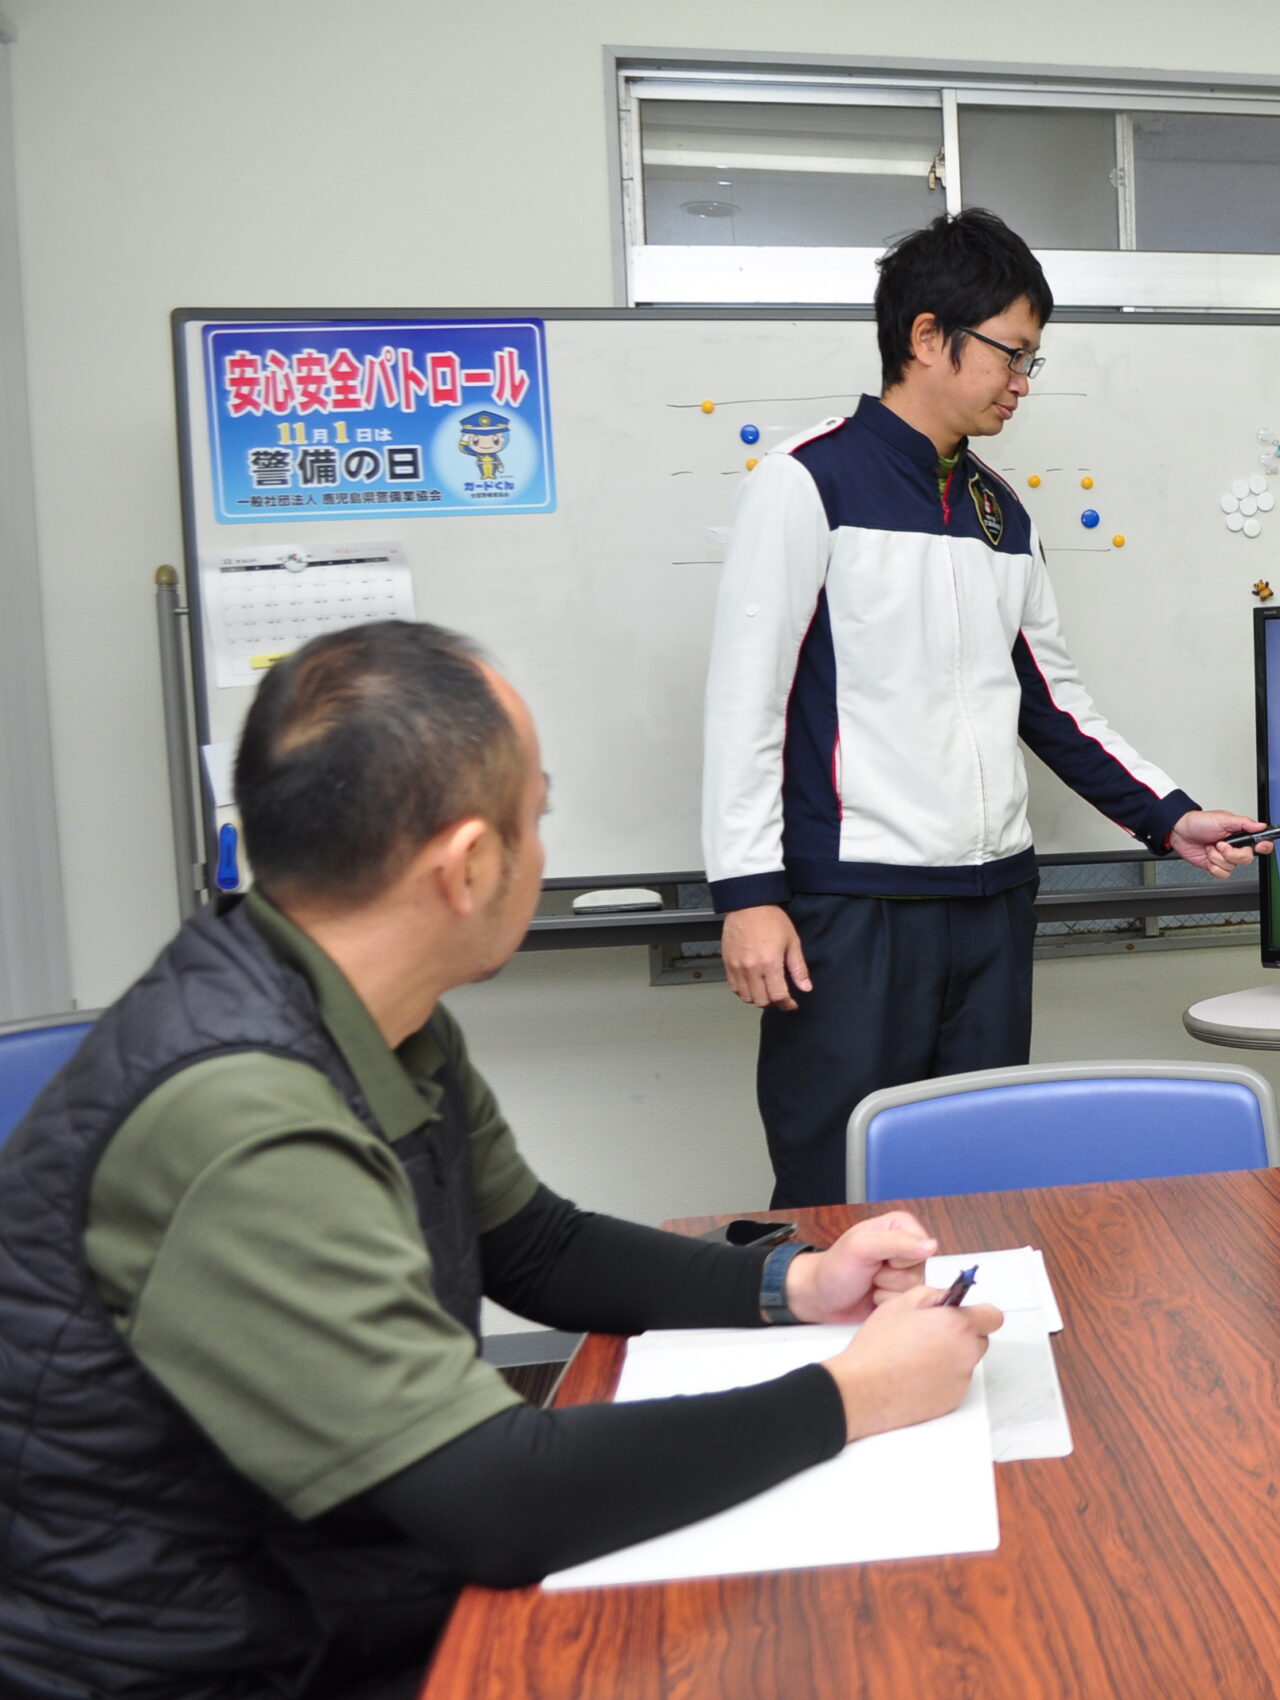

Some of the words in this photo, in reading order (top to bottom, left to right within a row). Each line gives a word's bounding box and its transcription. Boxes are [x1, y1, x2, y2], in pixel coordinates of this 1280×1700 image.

[225, 347, 529, 416] 安心安全パトロール
[277, 421, 393, 446] 11月1日は
[250, 446, 424, 487] 警備の日
[237, 494, 318, 508] 一般社団法人
[322, 489, 443, 506] 鹿児島県警備業協会
